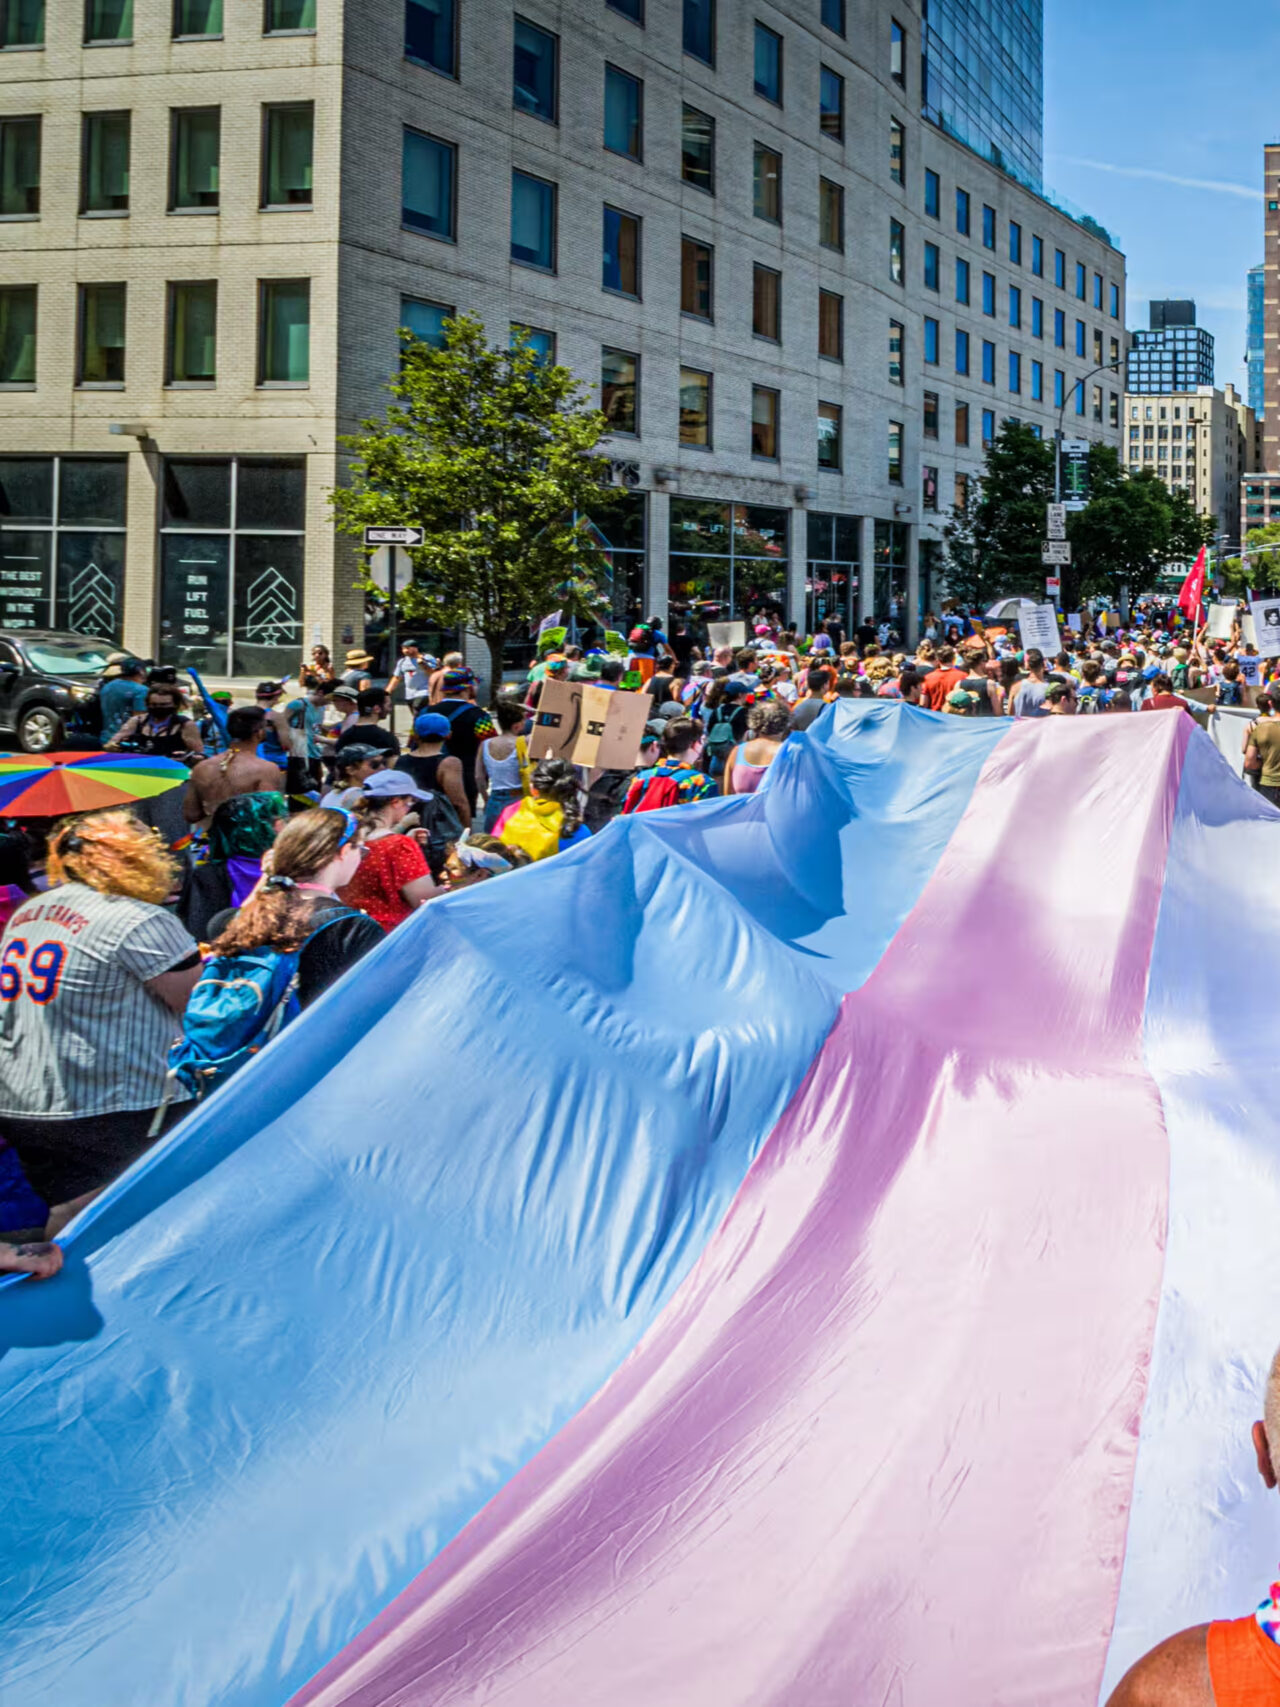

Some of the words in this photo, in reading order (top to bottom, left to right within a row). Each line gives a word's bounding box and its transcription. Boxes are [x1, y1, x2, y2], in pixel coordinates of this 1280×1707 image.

[19, 571, 43, 581] BEST
[187, 575, 208, 585] RUN
[186, 592, 208, 601] LIFT
[6, 603, 17, 612] IN
[17, 603, 35, 613] THE
[184, 608, 209, 618] FUEL
[183, 624, 210, 634] SHOP
[0, 937, 69, 1005] 69
